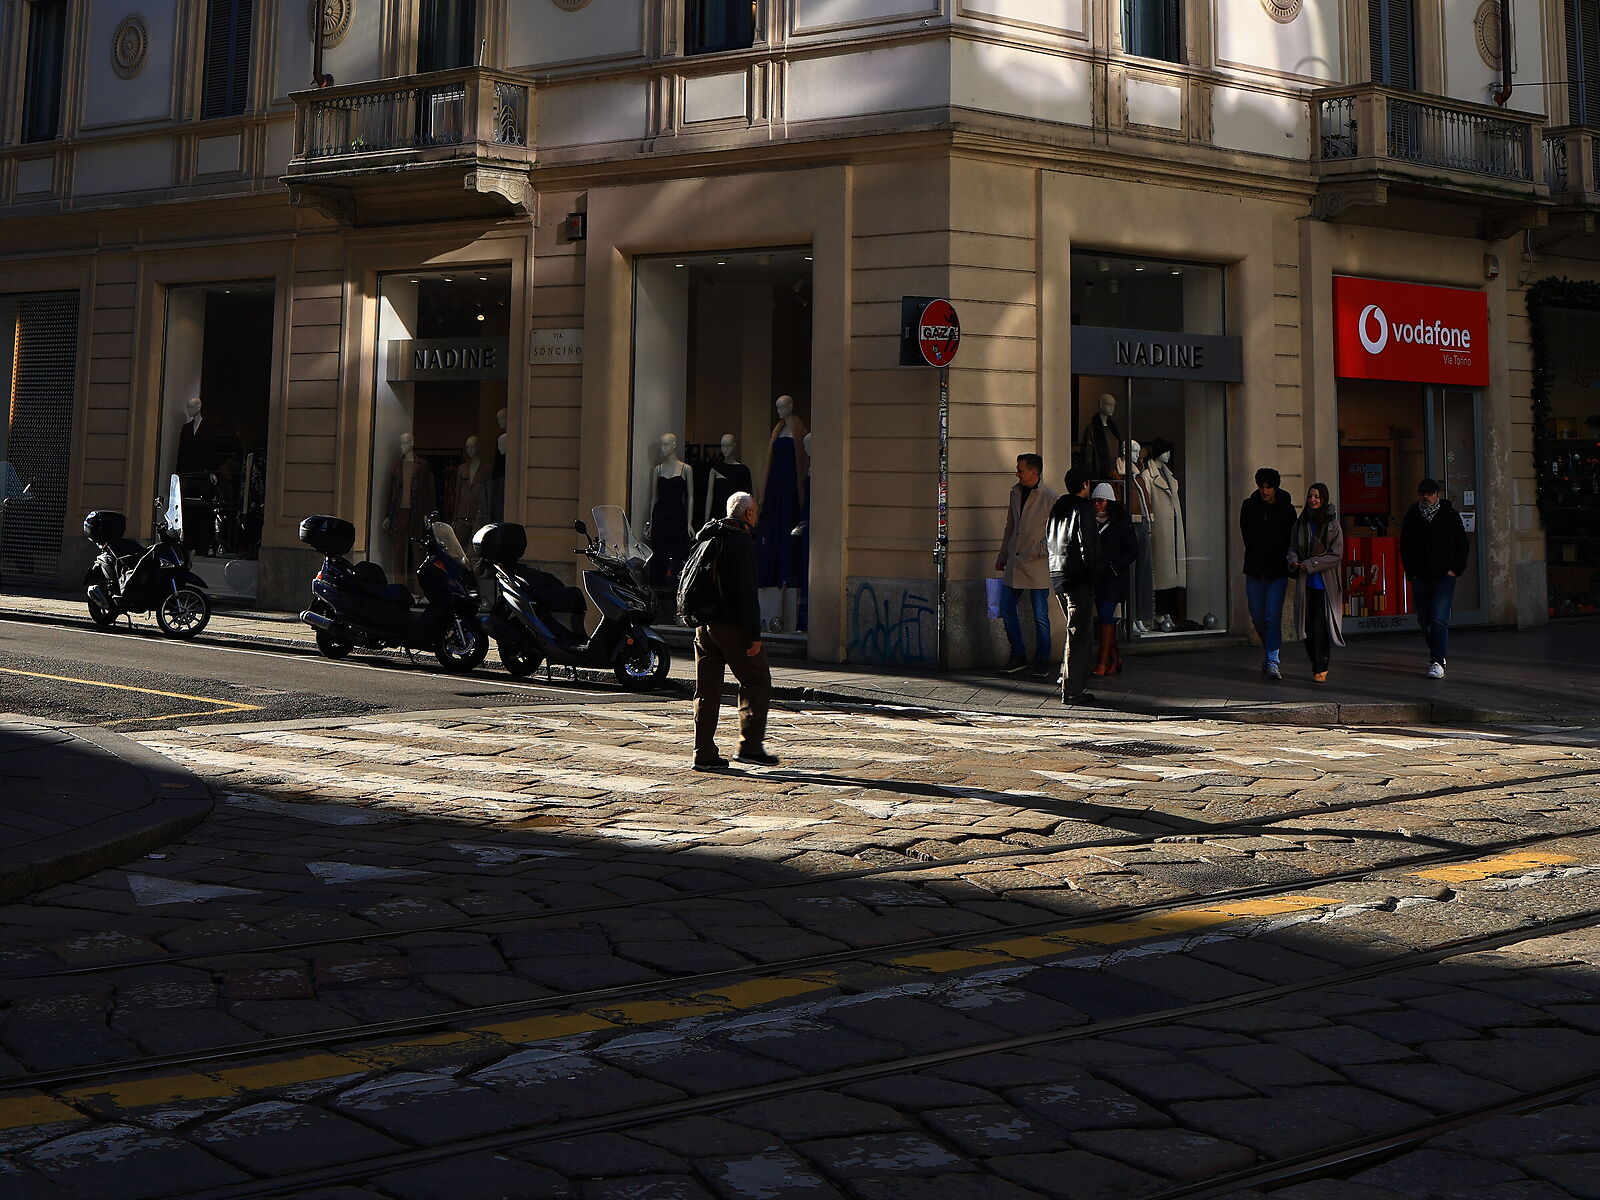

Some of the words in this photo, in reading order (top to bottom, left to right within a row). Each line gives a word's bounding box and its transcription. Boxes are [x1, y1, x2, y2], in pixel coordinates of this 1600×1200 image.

[1392, 319, 1471, 348] vodafone
[414, 348, 497, 370] NADINE
[533, 346, 582, 356] SONCINO
[1115, 341, 1204, 369] NADINE
[1443, 354, 1452, 364] Via
[1453, 355, 1472, 366] Torino
